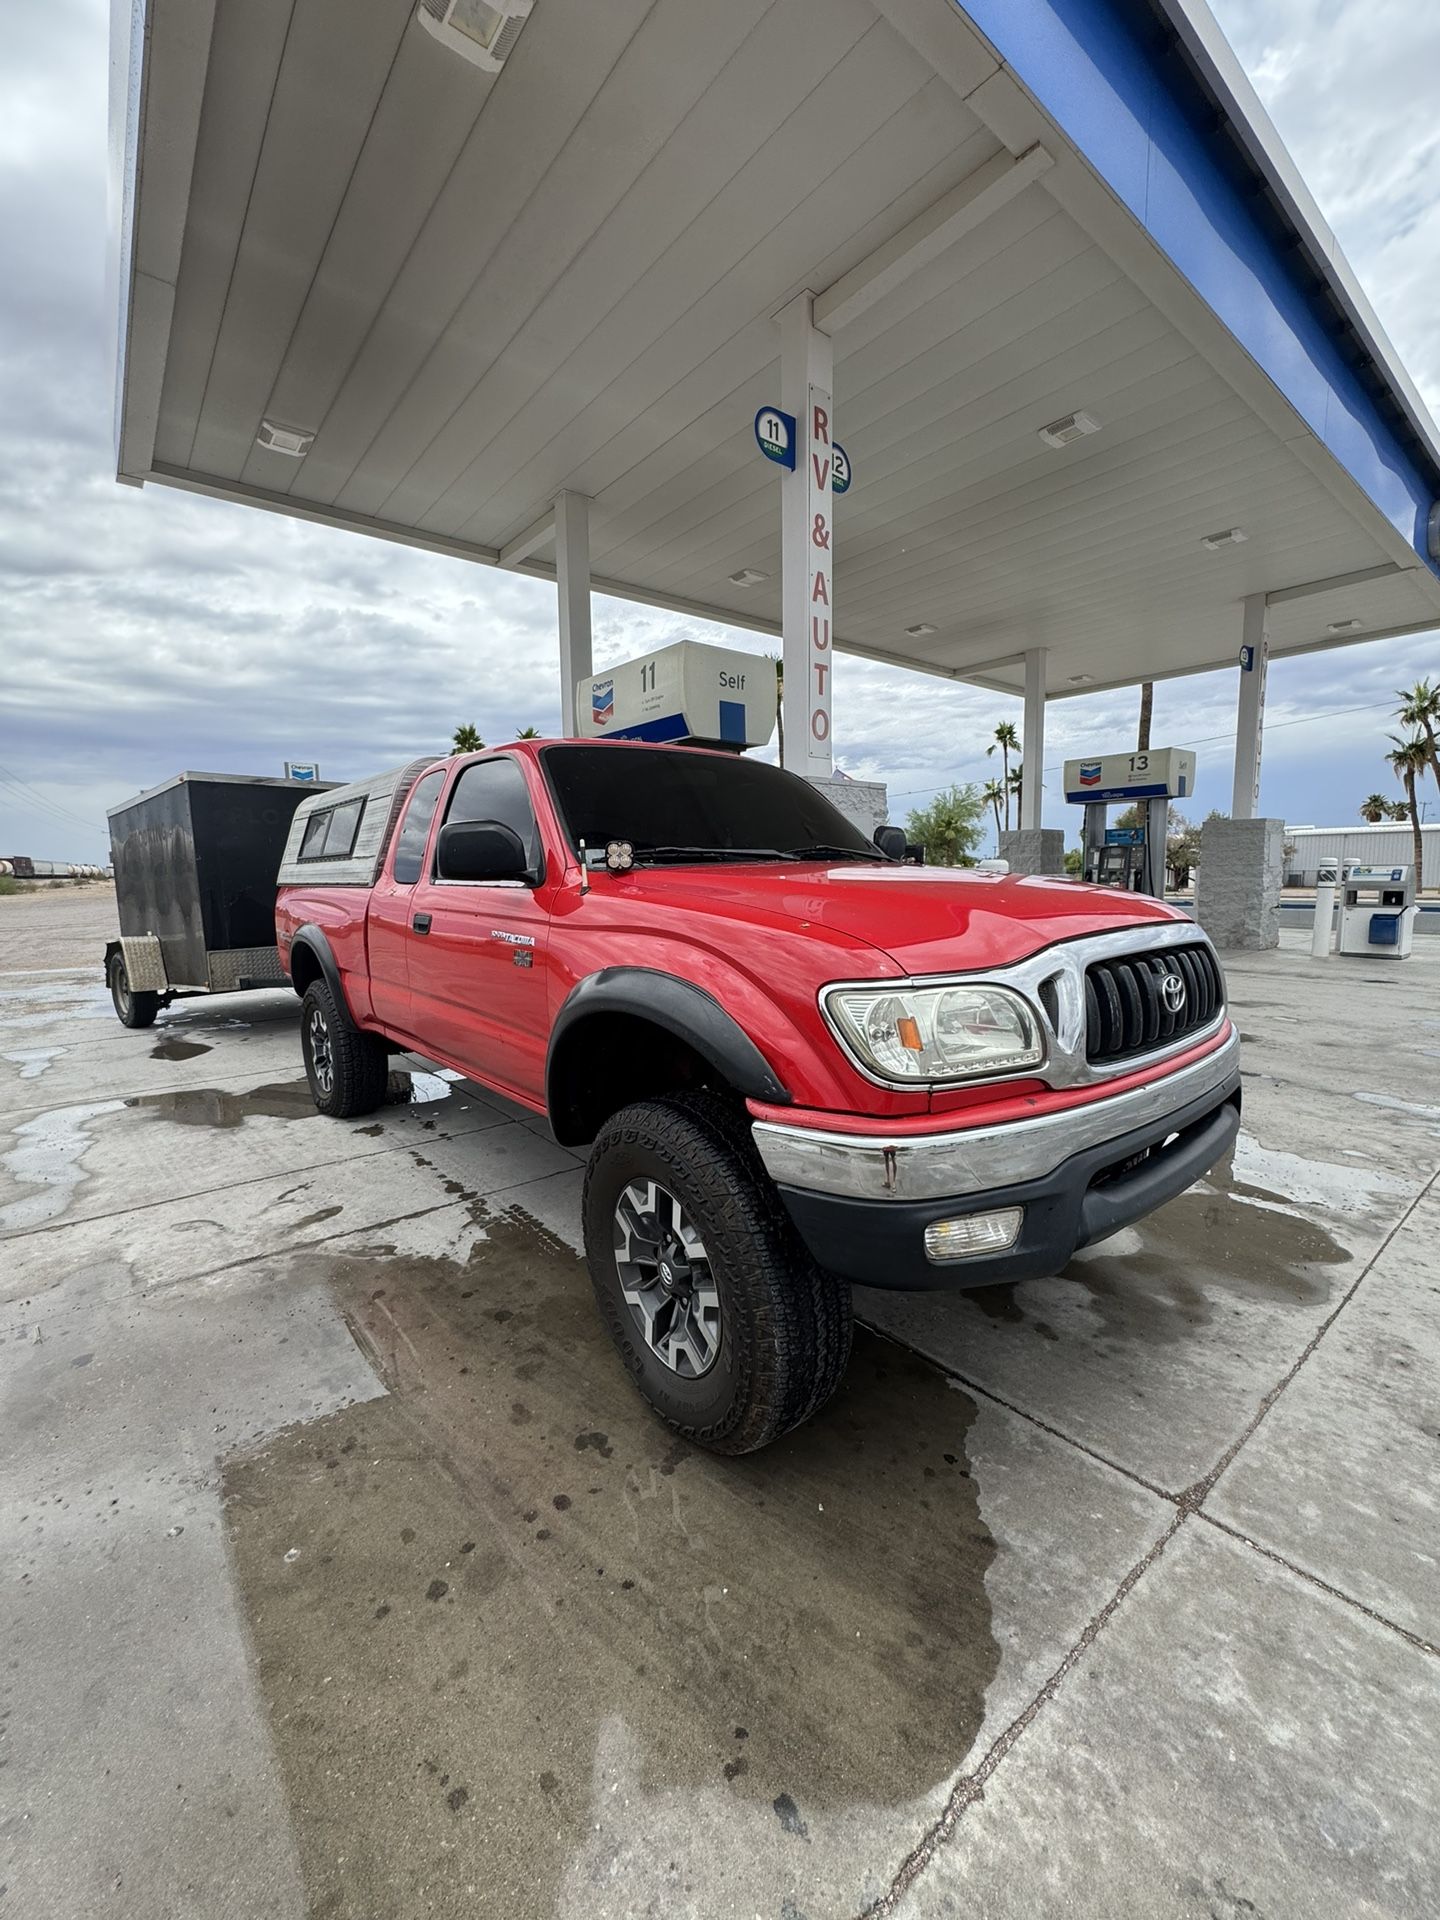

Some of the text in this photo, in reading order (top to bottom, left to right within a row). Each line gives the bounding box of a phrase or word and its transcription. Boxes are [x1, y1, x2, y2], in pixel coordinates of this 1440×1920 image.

[767, 418, 779, 441] 11
[763, 441, 783, 455] DIESEL
[811, 513, 829, 550] &
[592, 679, 613, 693] Chevron
[640, 661, 656, 693] 11
[719, 672, 746, 690] Self
[1128, 755, 1149, 772] 13
